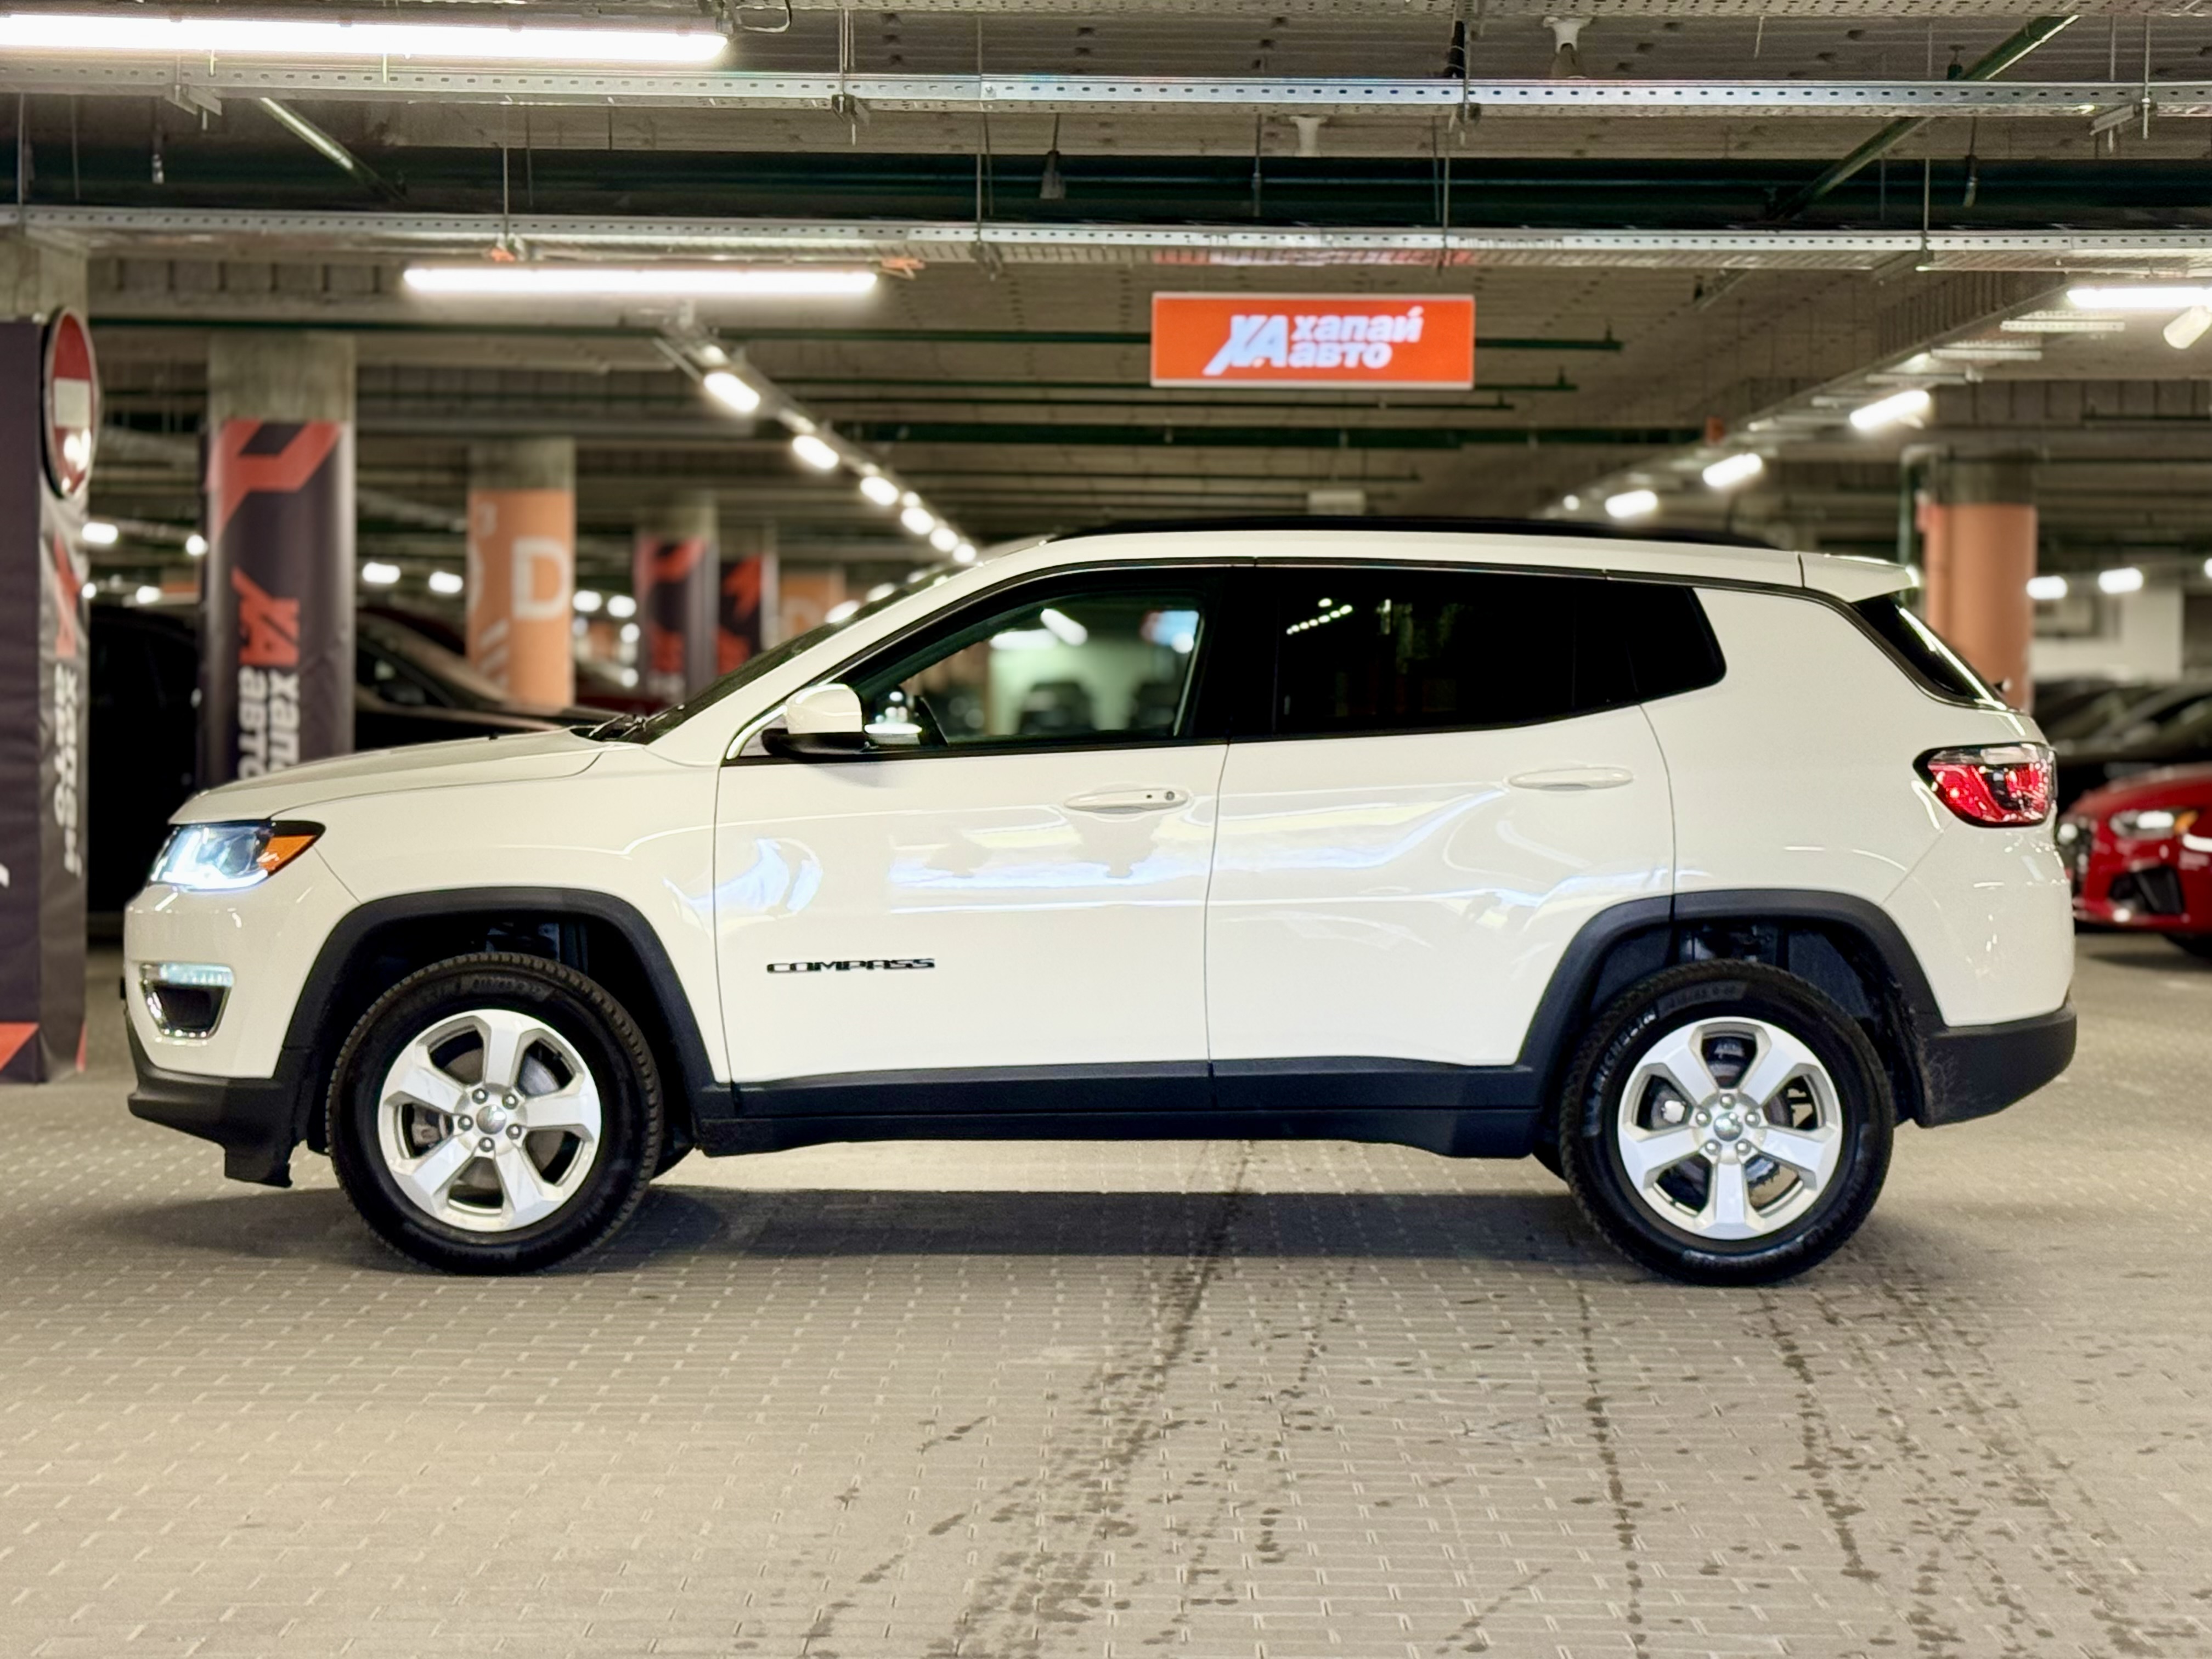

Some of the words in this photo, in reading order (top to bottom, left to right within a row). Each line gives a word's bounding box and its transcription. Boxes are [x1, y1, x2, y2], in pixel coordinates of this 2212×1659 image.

[1291, 306, 1424, 343] хапай
[1289, 342, 1392, 369] авто
[767, 958, 935, 973] COMPASS
